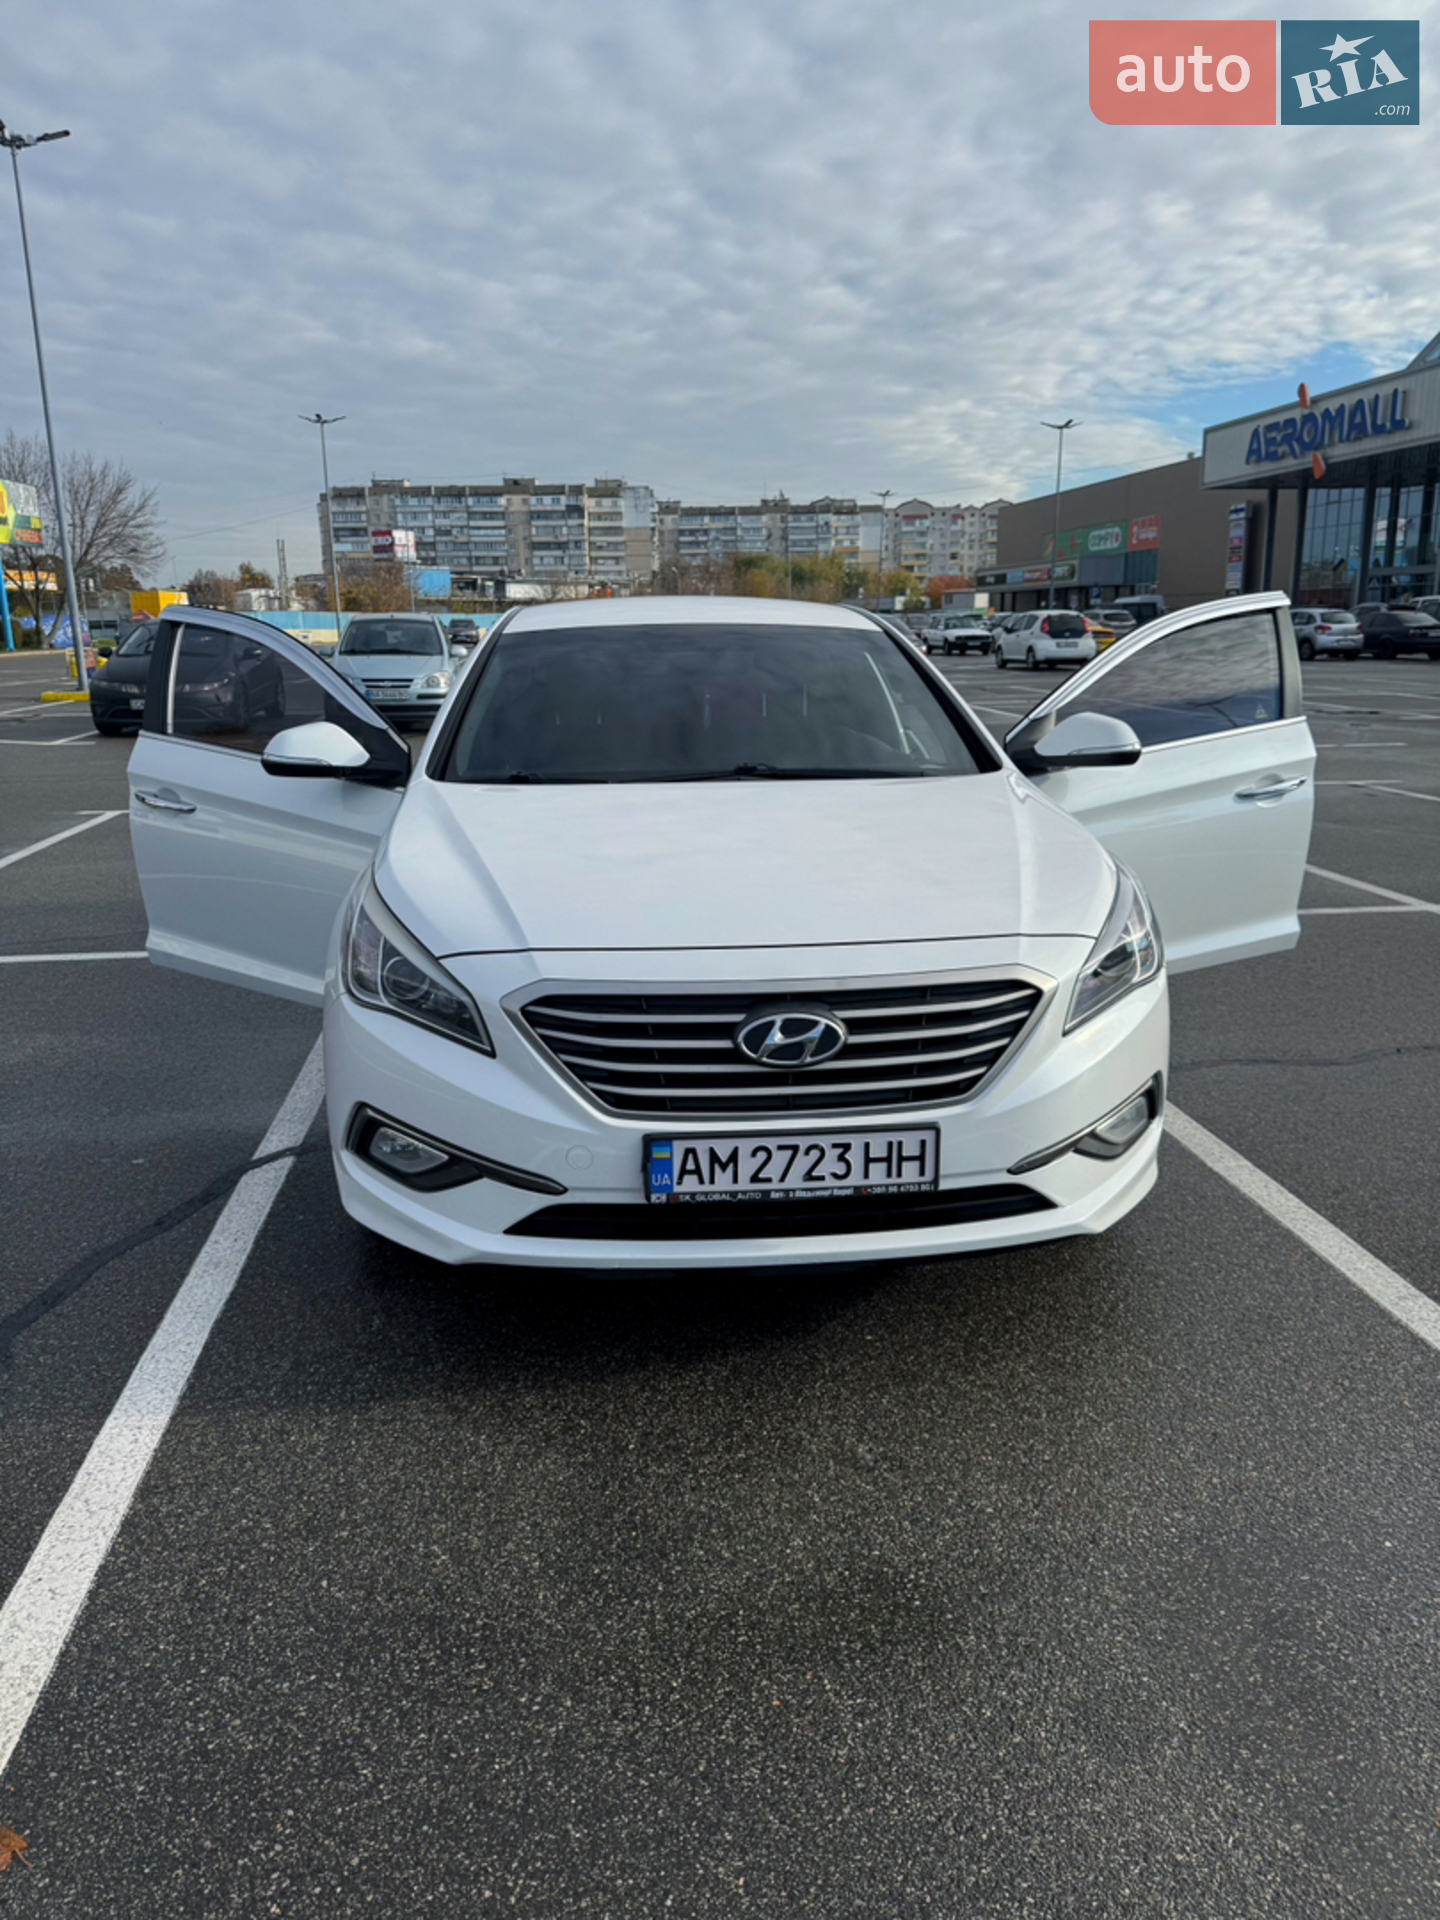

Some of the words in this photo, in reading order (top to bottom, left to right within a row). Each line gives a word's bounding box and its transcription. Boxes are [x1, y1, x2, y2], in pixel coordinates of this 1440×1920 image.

[1246, 387, 1407, 465] AEROMALL
[652, 1174, 671, 1187] UA
[676, 1145, 739, 1186] AM
[749, 1142, 853, 1183] 2723
[863, 1138, 927, 1180] HH
